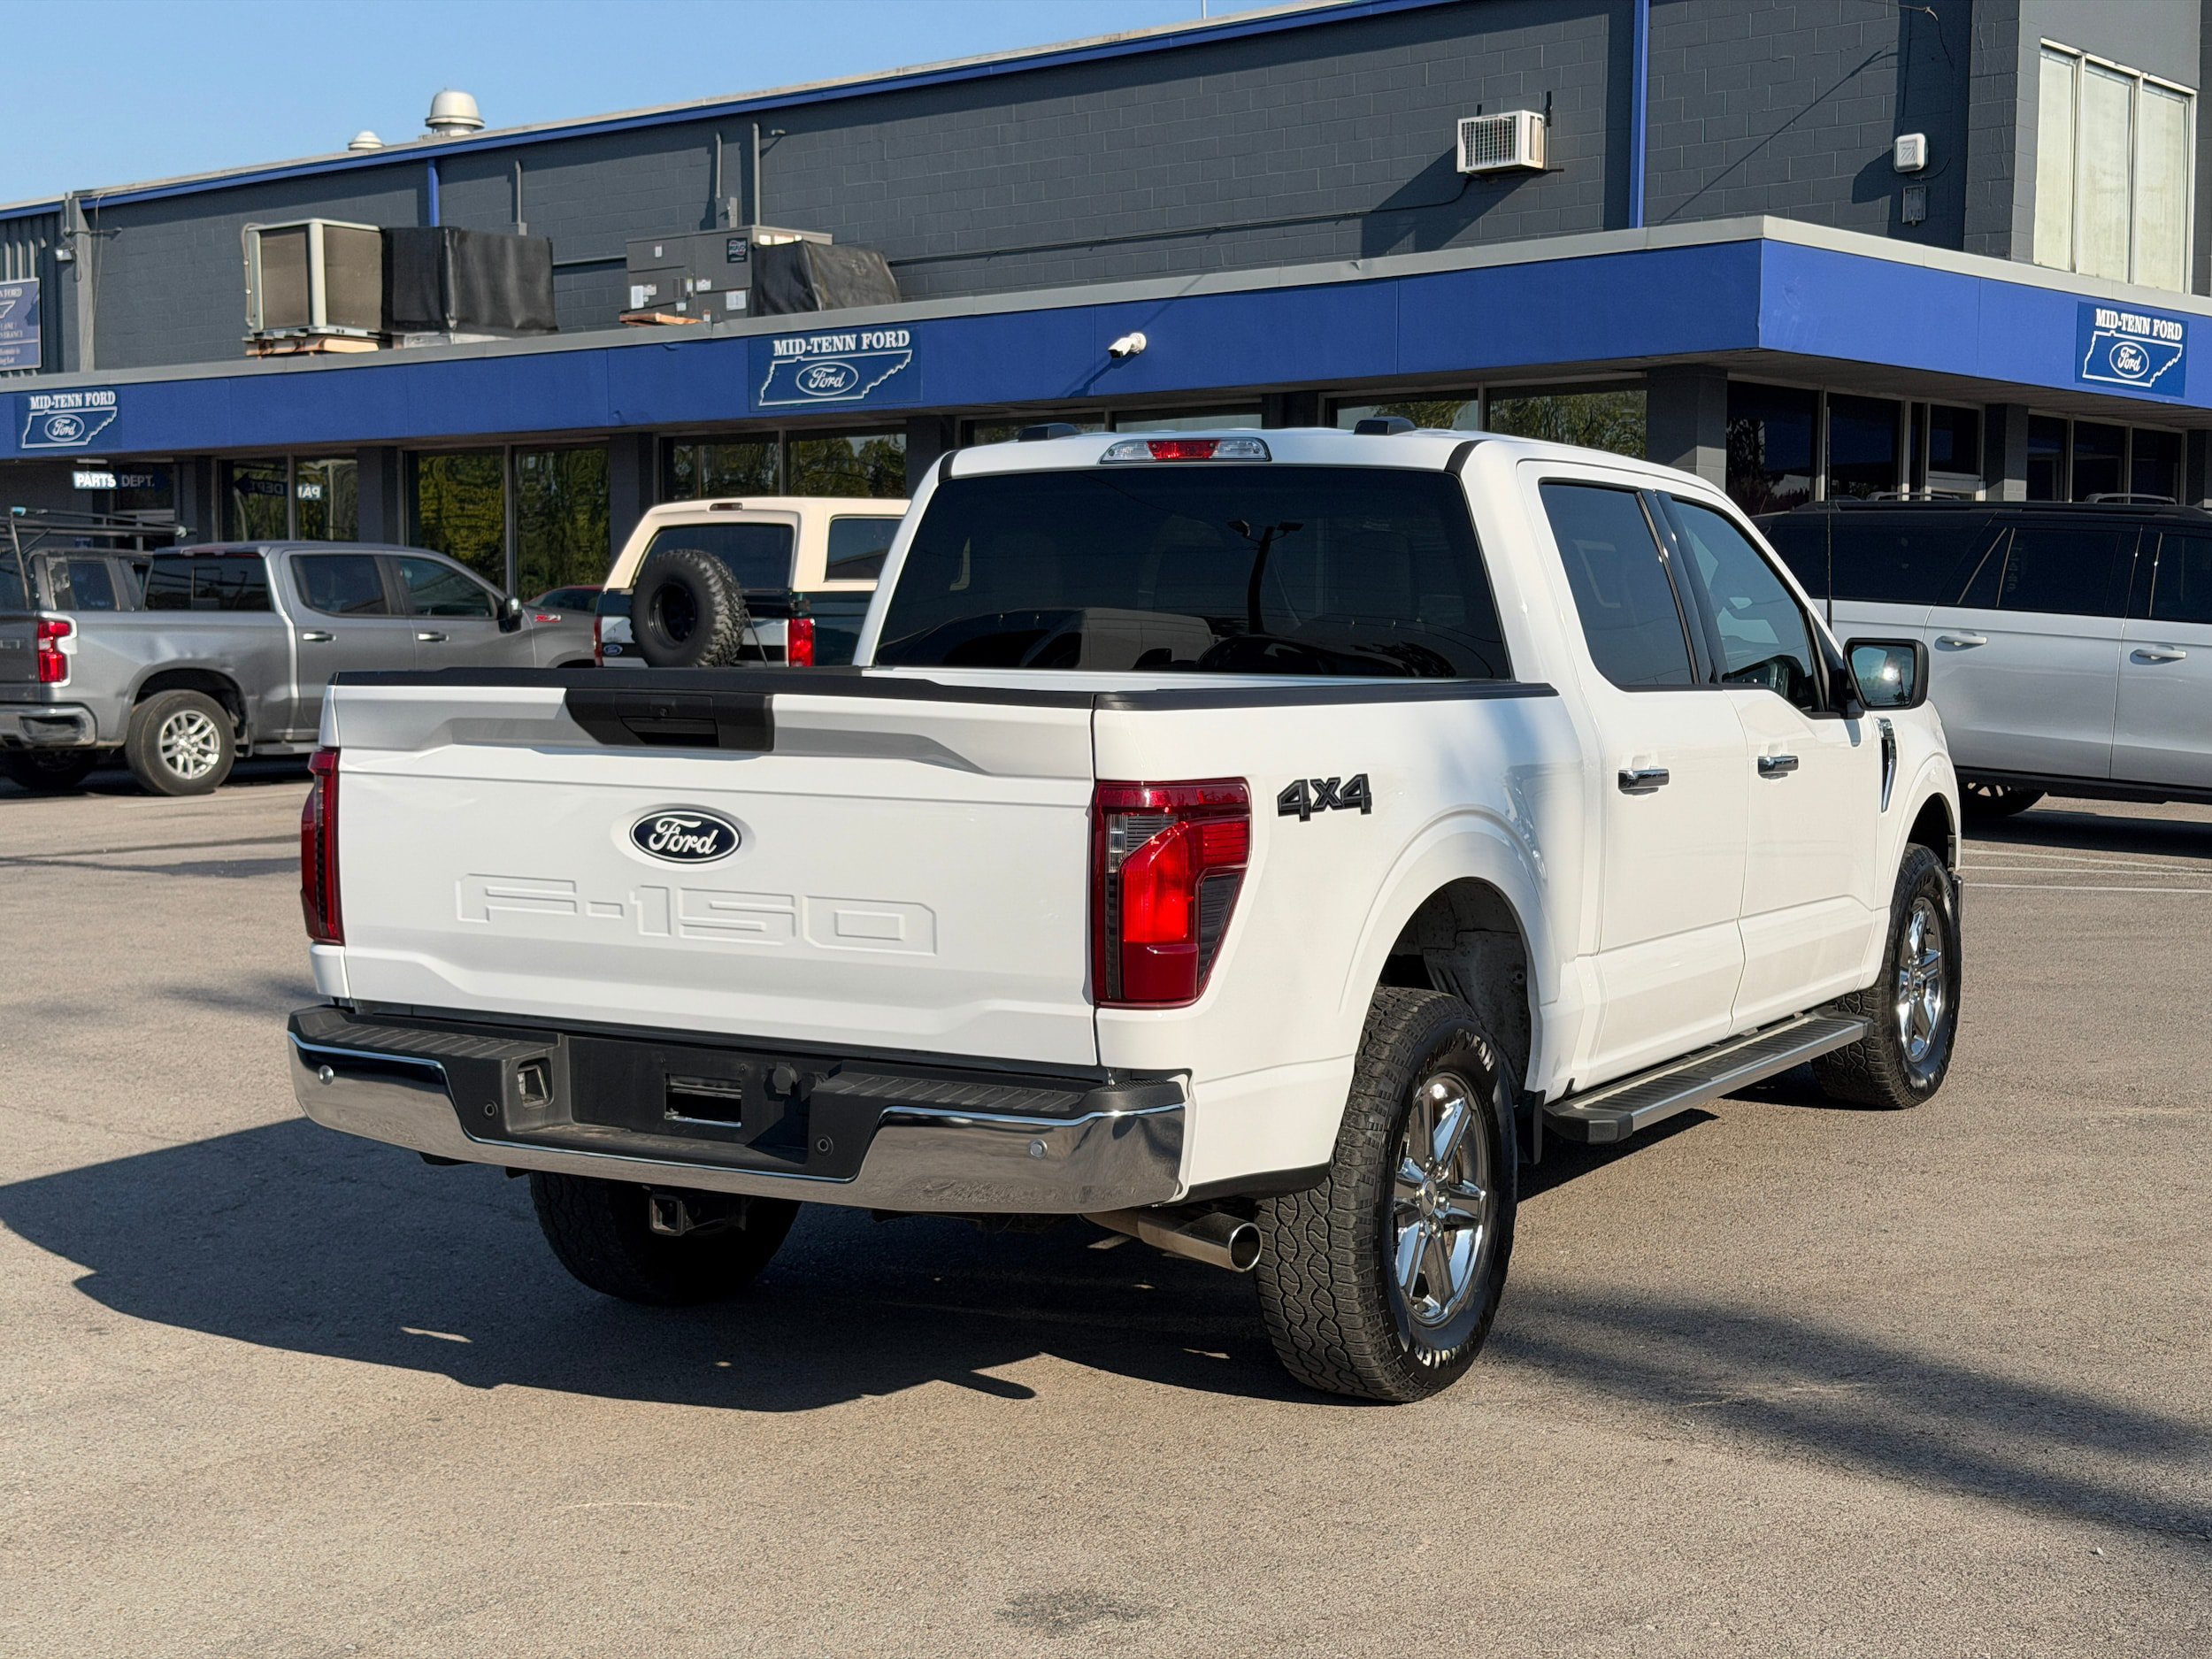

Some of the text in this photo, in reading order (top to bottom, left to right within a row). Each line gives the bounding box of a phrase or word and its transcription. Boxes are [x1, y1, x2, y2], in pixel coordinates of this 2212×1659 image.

[2094, 308, 2183, 341] MID-TENN FORD
[773, 330, 910, 357] MID-TENN FORD
[2116, 347, 2142, 372] Ford
[808, 367, 846, 388] Ford
[29, 391, 116, 410] MID-TENN FORD
[52, 419, 77, 436] Ford
[75, 472, 155, 488] PARTS DEPT.
[648, 816, 718, 856] Ford
[455, 873, 938, 956] F-150
